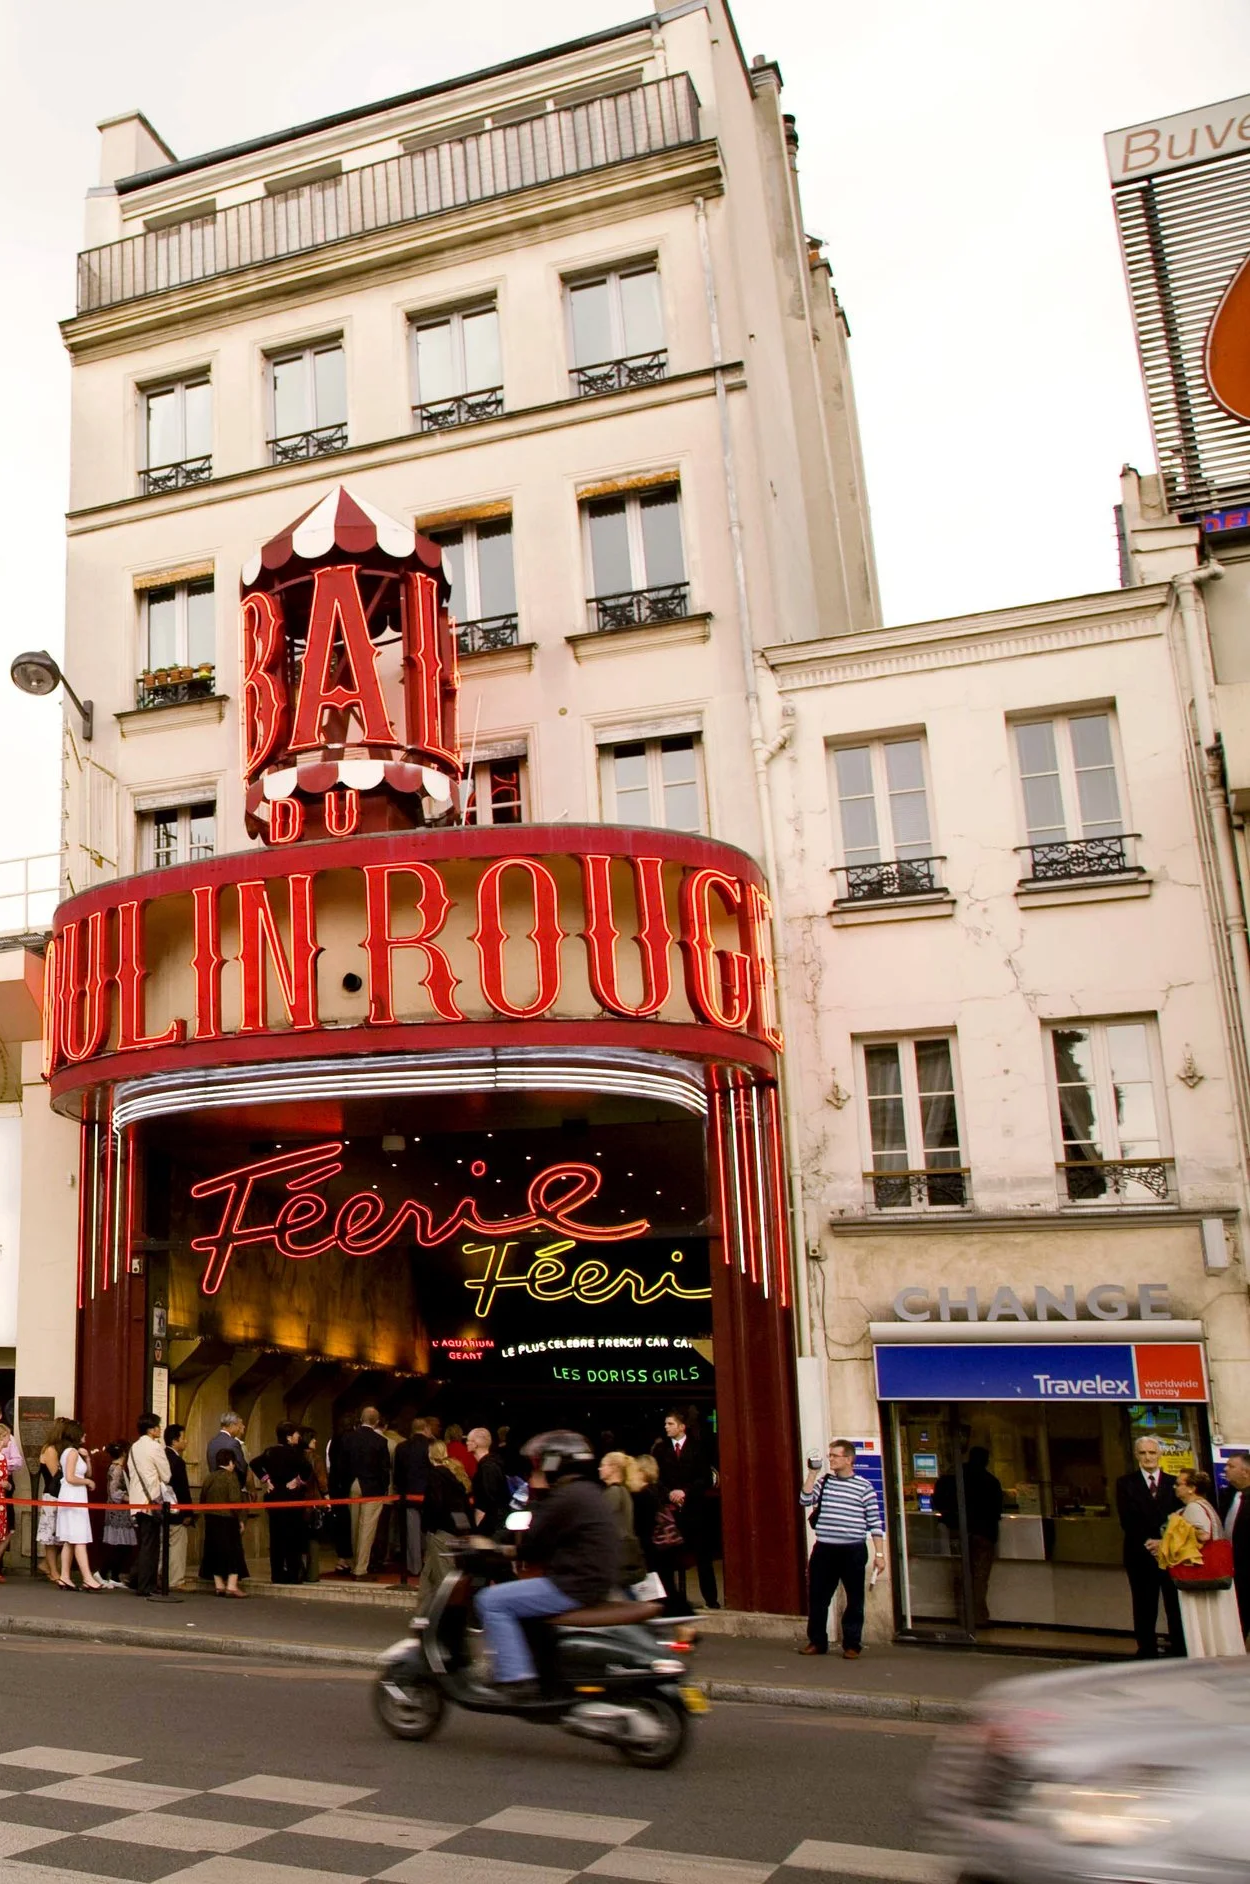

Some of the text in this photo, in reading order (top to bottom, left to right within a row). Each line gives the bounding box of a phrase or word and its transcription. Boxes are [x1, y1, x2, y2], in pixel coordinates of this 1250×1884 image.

[239, 564, 464, 789] BAL
[269, 790, 360, 844] DU
[363, 853, 785, 1053] ROUGE
[191, 1141, 650, 1295] Féerie
[893, 1283, 1172, 1322] CHANGE
[502, 1346, 516, 1358] LE
[518, 1341, 547, 1355] PLUS
[598, 1337, 643, 1348] FRENCH
[553, 1366, 700, 1383] LES DORISS GIRLS
[1033, 1374, 1131, 1395] Travelex
[1144, 1379, 1199, 1388] worldwide
[1144, 1388, 1180, 1397] money
